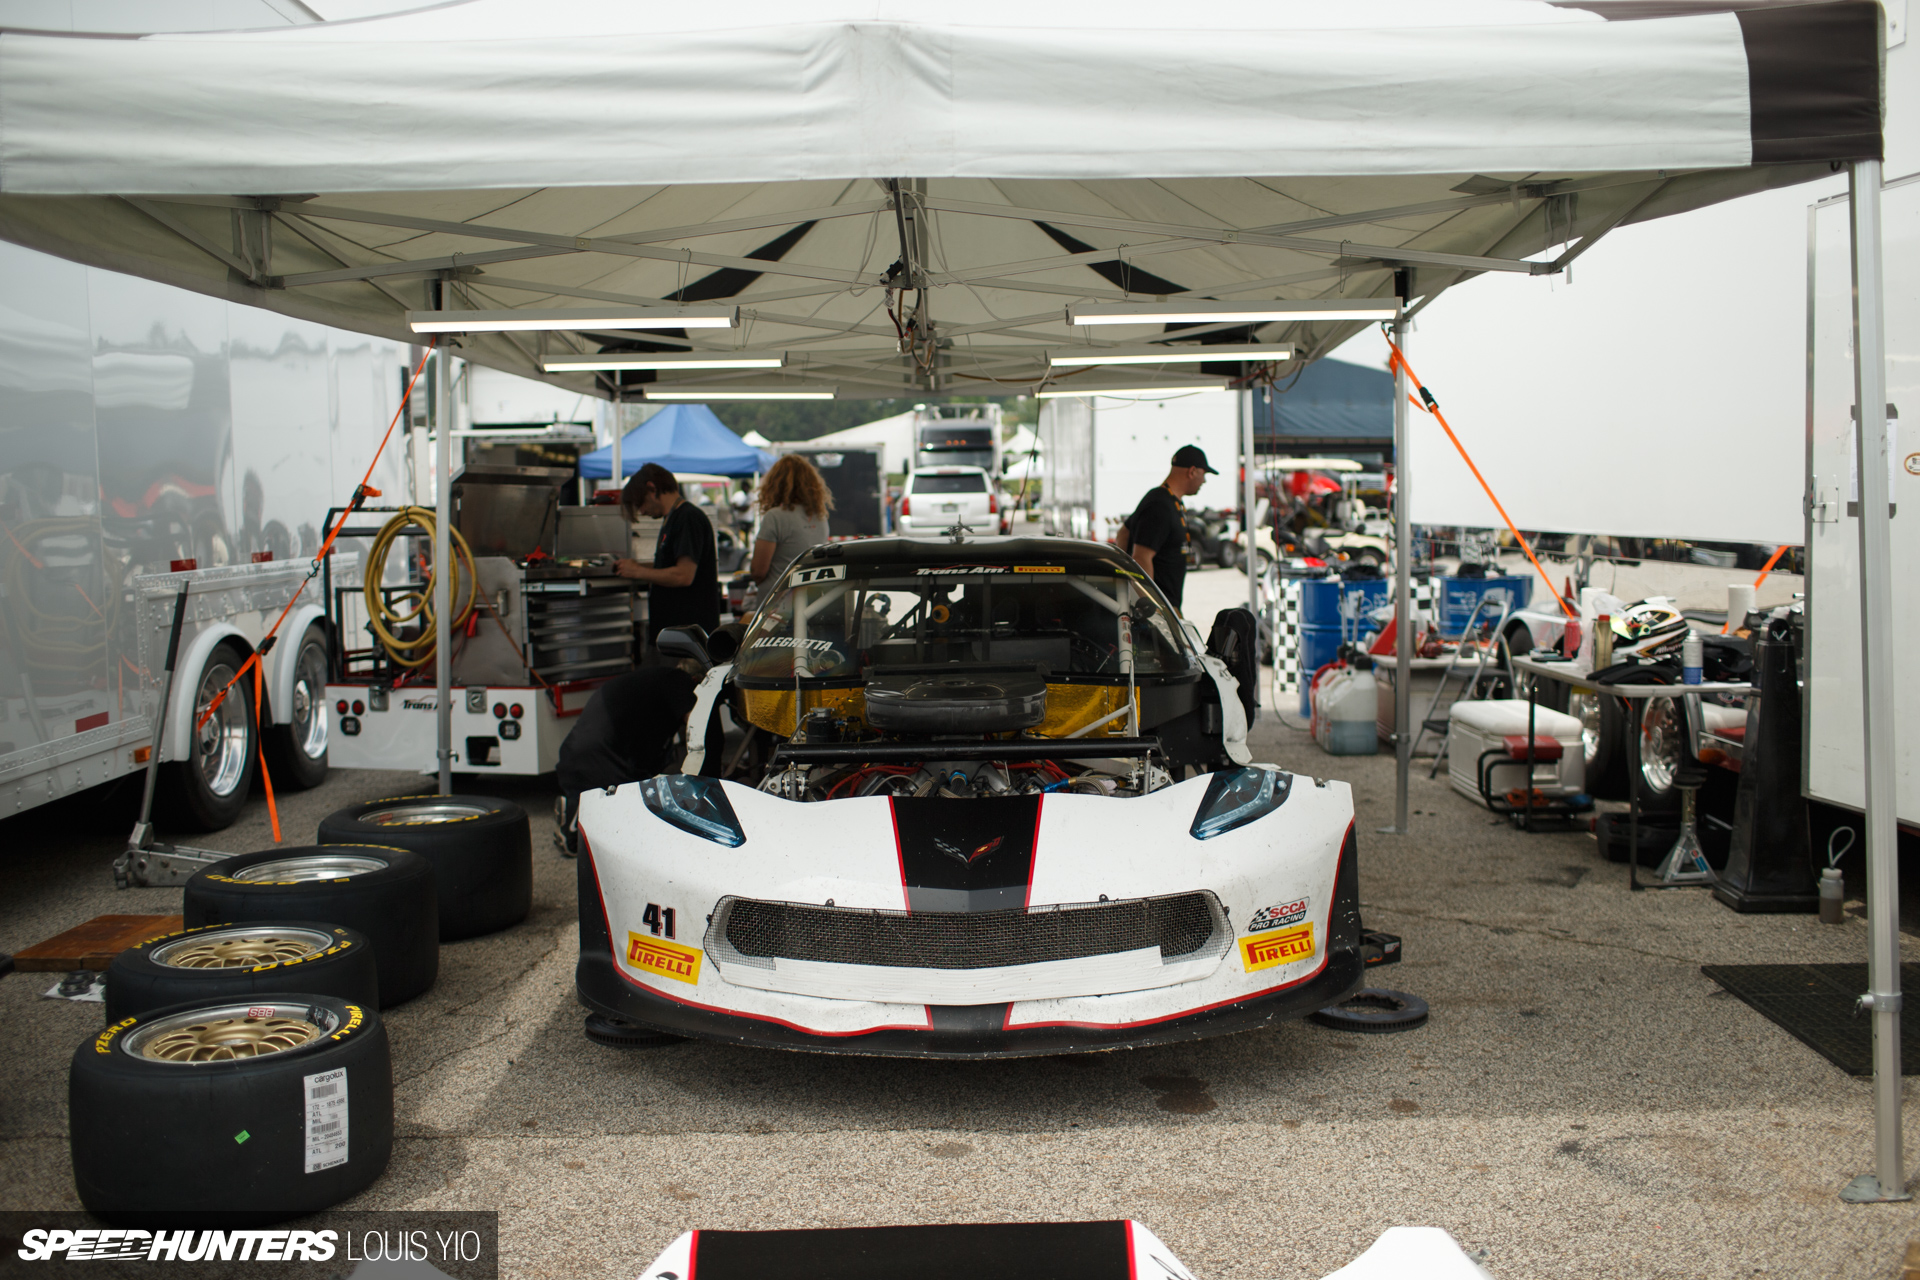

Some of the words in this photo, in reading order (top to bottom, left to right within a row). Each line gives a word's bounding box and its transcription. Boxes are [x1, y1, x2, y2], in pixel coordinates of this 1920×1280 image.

[798, 567, 838, 583] TA
[917, 567, 968, 576] Trans
[968, 566, 1005, 575] Am
[750, 636, 834, 652] ALLEGRETTA
[403, 699, 433, 710] Trans
[1270, 901, 1306, 919] SCCA
[642, 902, 676, 940] 41
[1249, 920, 1271, 931] PRO
[1271, 911, 1305, 927] RACING
[1246, 930, 1312, 965] PIRELLI
[630, 939, 696, 977] PIRELLI
[249, 1008, 274, 1018] BBS
[331, 1004, 364, 1041] PIRELLI
[95, 1016, 138, 1056] PZERO
[314, 1071, 344, 1084] cargolux
[335, 1140, 346, 1149] 200
[322, 1157, 345, 1168] SCHENKER
